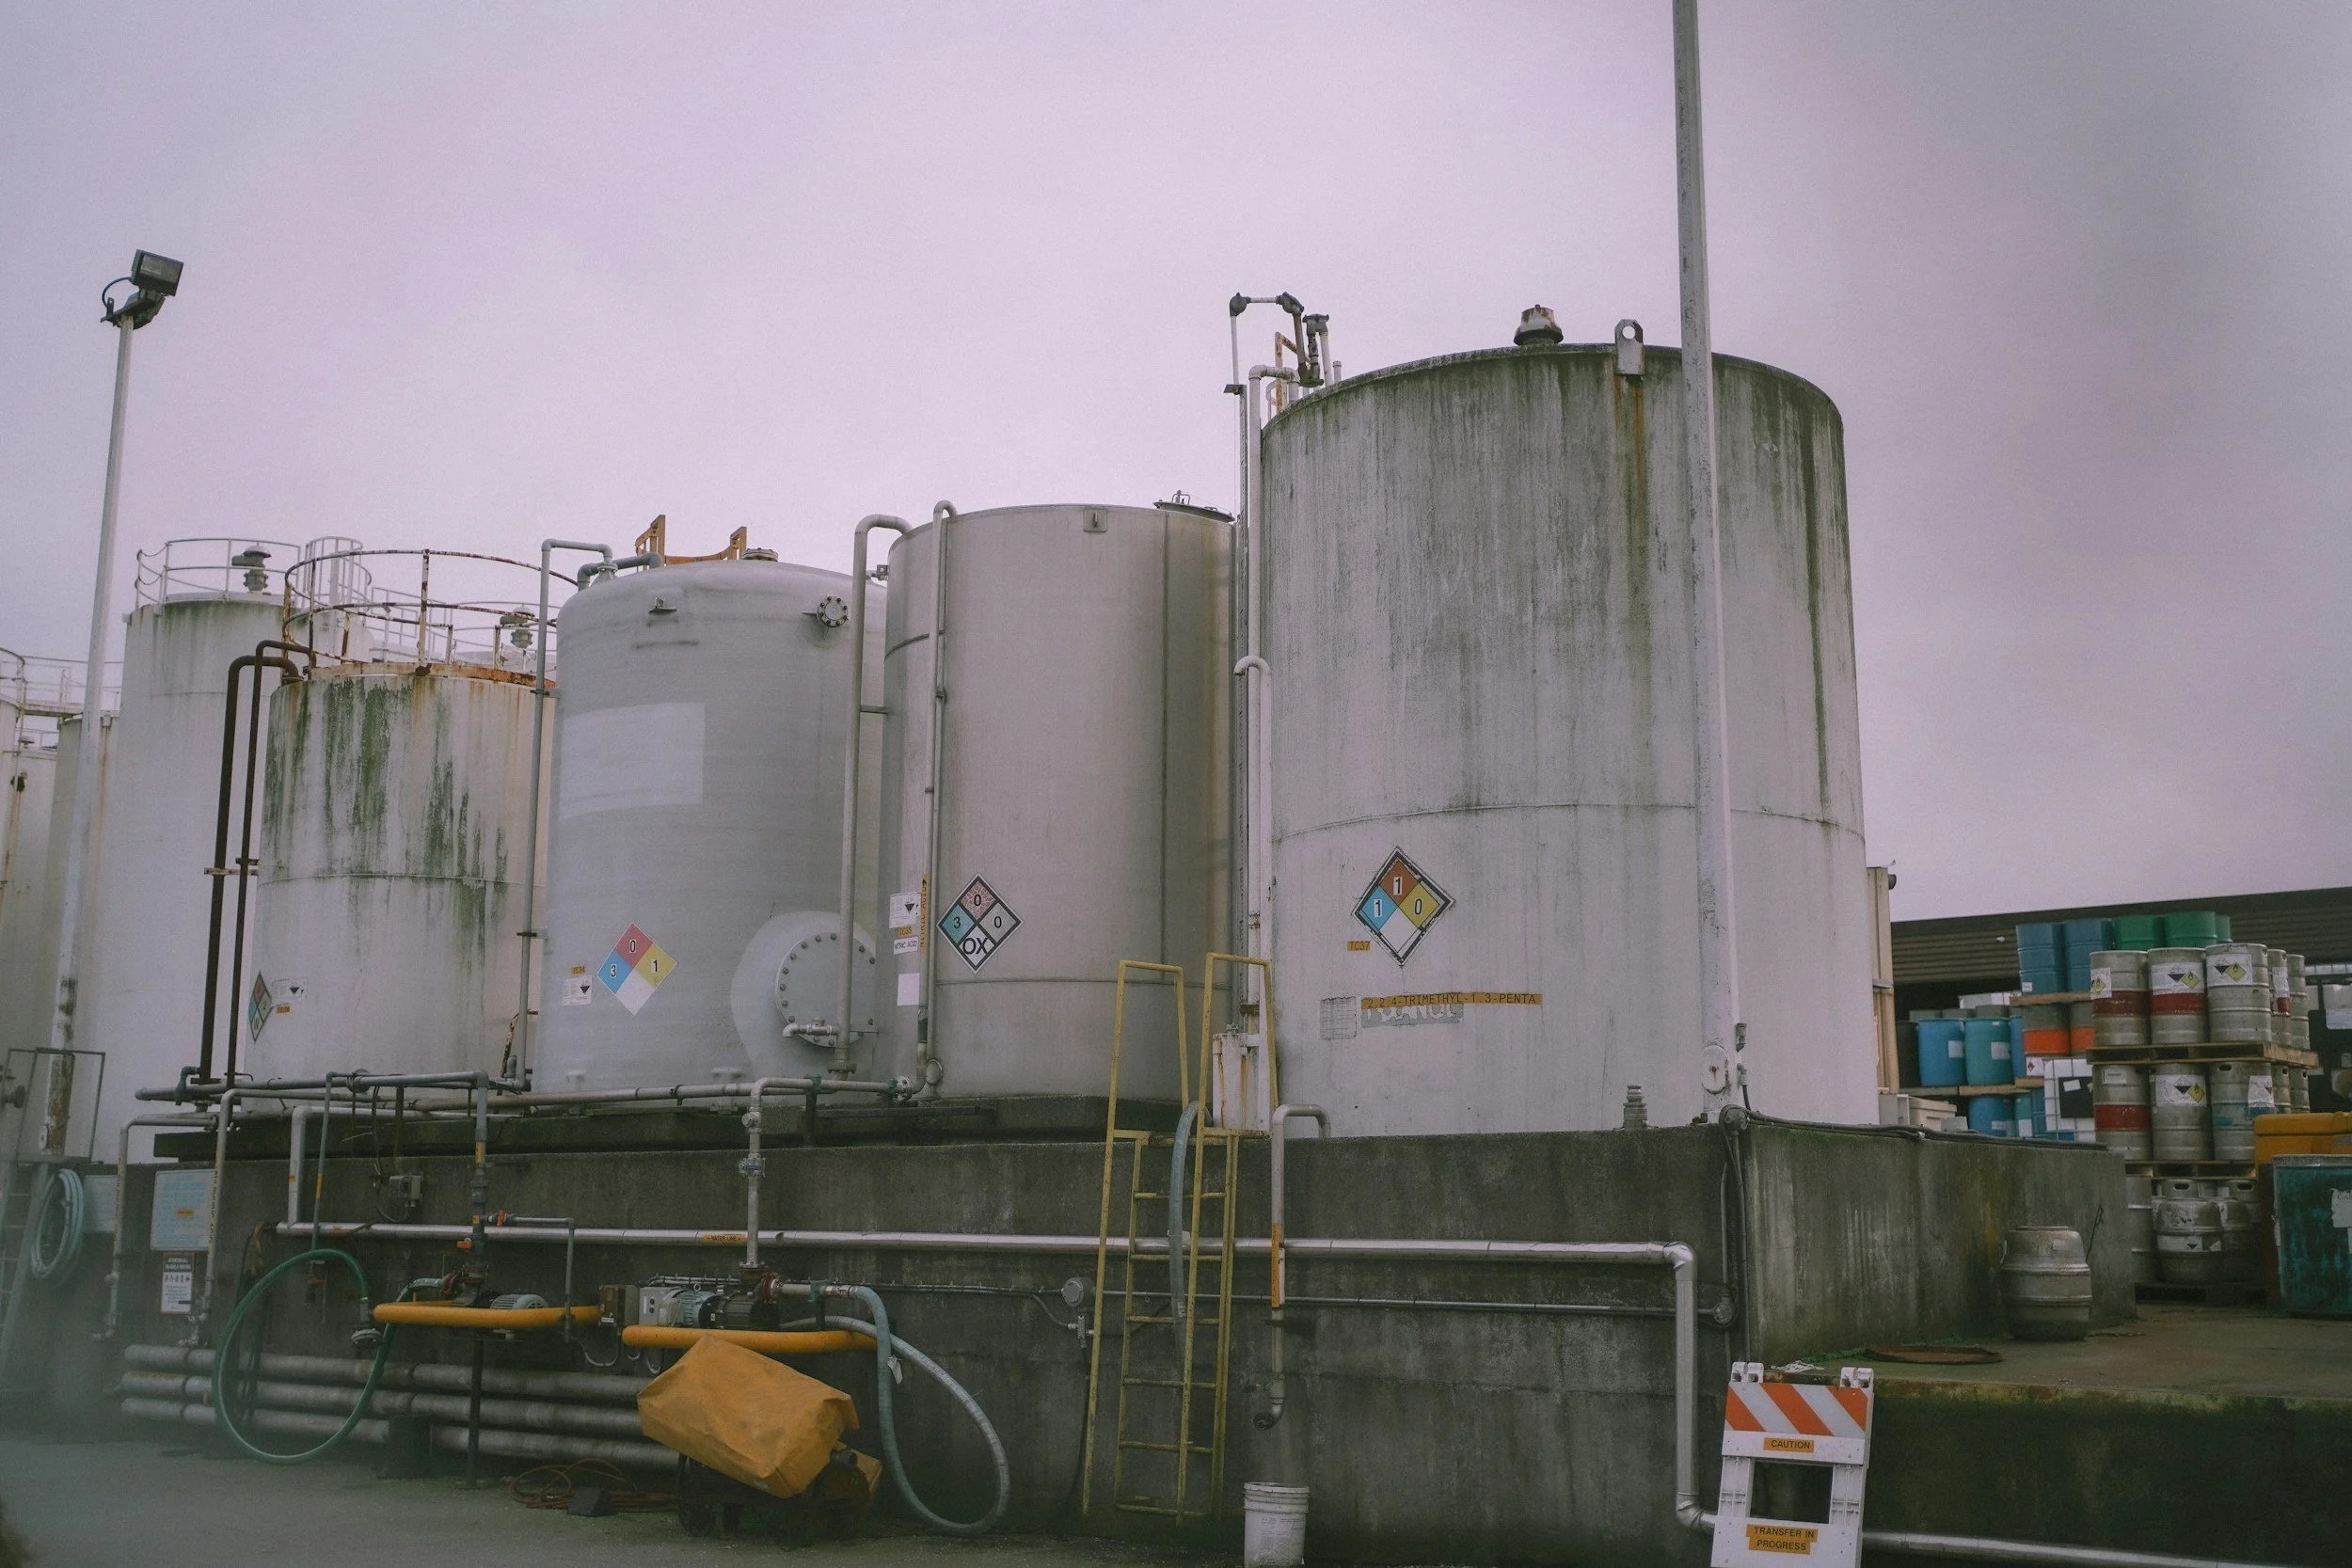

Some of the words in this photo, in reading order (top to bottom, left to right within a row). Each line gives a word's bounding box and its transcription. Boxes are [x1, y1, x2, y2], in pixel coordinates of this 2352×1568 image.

[1395, 877, 1402, 895] 1
[974, 894, 982, 907] 0
[1414, 898, 1422, 915] 0
[1375, 899, 1381, 917] 1
[953, 916, 961, 929] 3
[993, 915, 1003, 928] 0
[629, 940, 636, 953] 0
[961, 937, 988, 955] OX
[1349, 941, 1371, 951] TC37
[611, 964, 617, 977] 3
[653, 958, 659, 973] 1
[1771, 1439, 1811, 1449] CAUTION
[1754, 1527, 1802, 1538] TRANSFER
[1805, 1529, 1815, 1539] IN
[1756, 1539, 1807, 1551] PROGRESS
